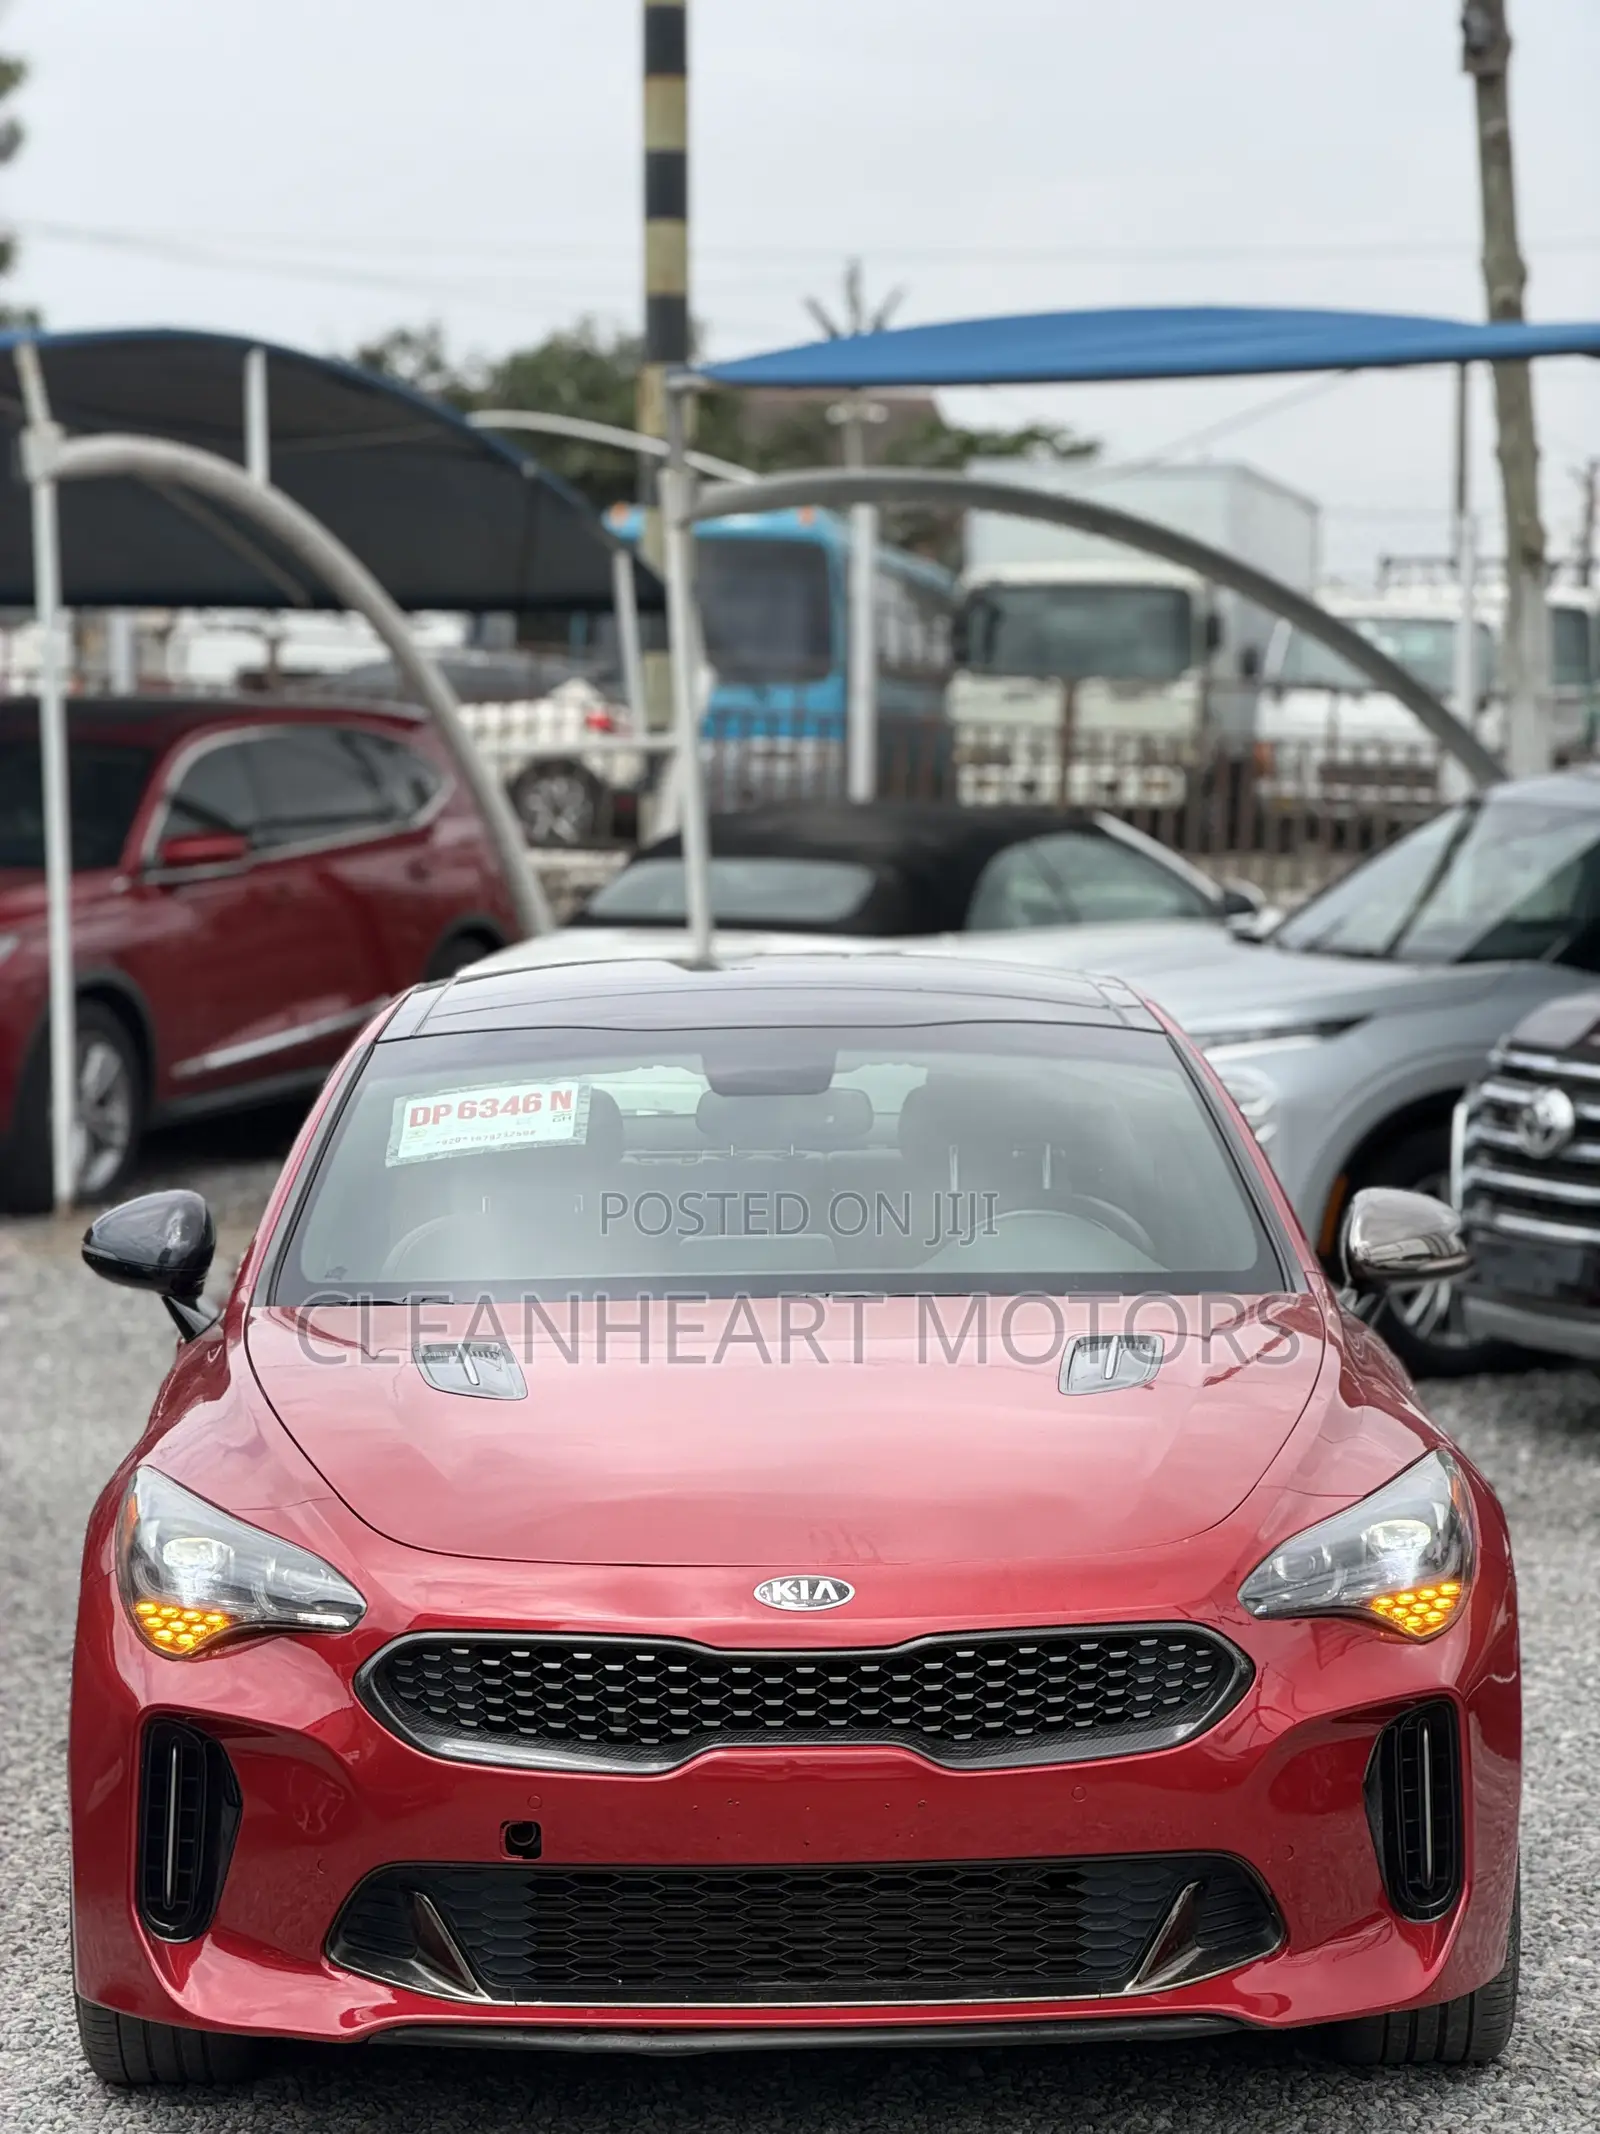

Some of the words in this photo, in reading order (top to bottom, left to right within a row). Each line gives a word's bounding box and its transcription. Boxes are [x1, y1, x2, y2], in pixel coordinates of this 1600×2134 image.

[409, 1103, 453, 1128] DP
[457, 1092, 543, 1120] 6346
[550, 1089, 573, 1112] N
[771, 1579, 840, 1601] KIA
